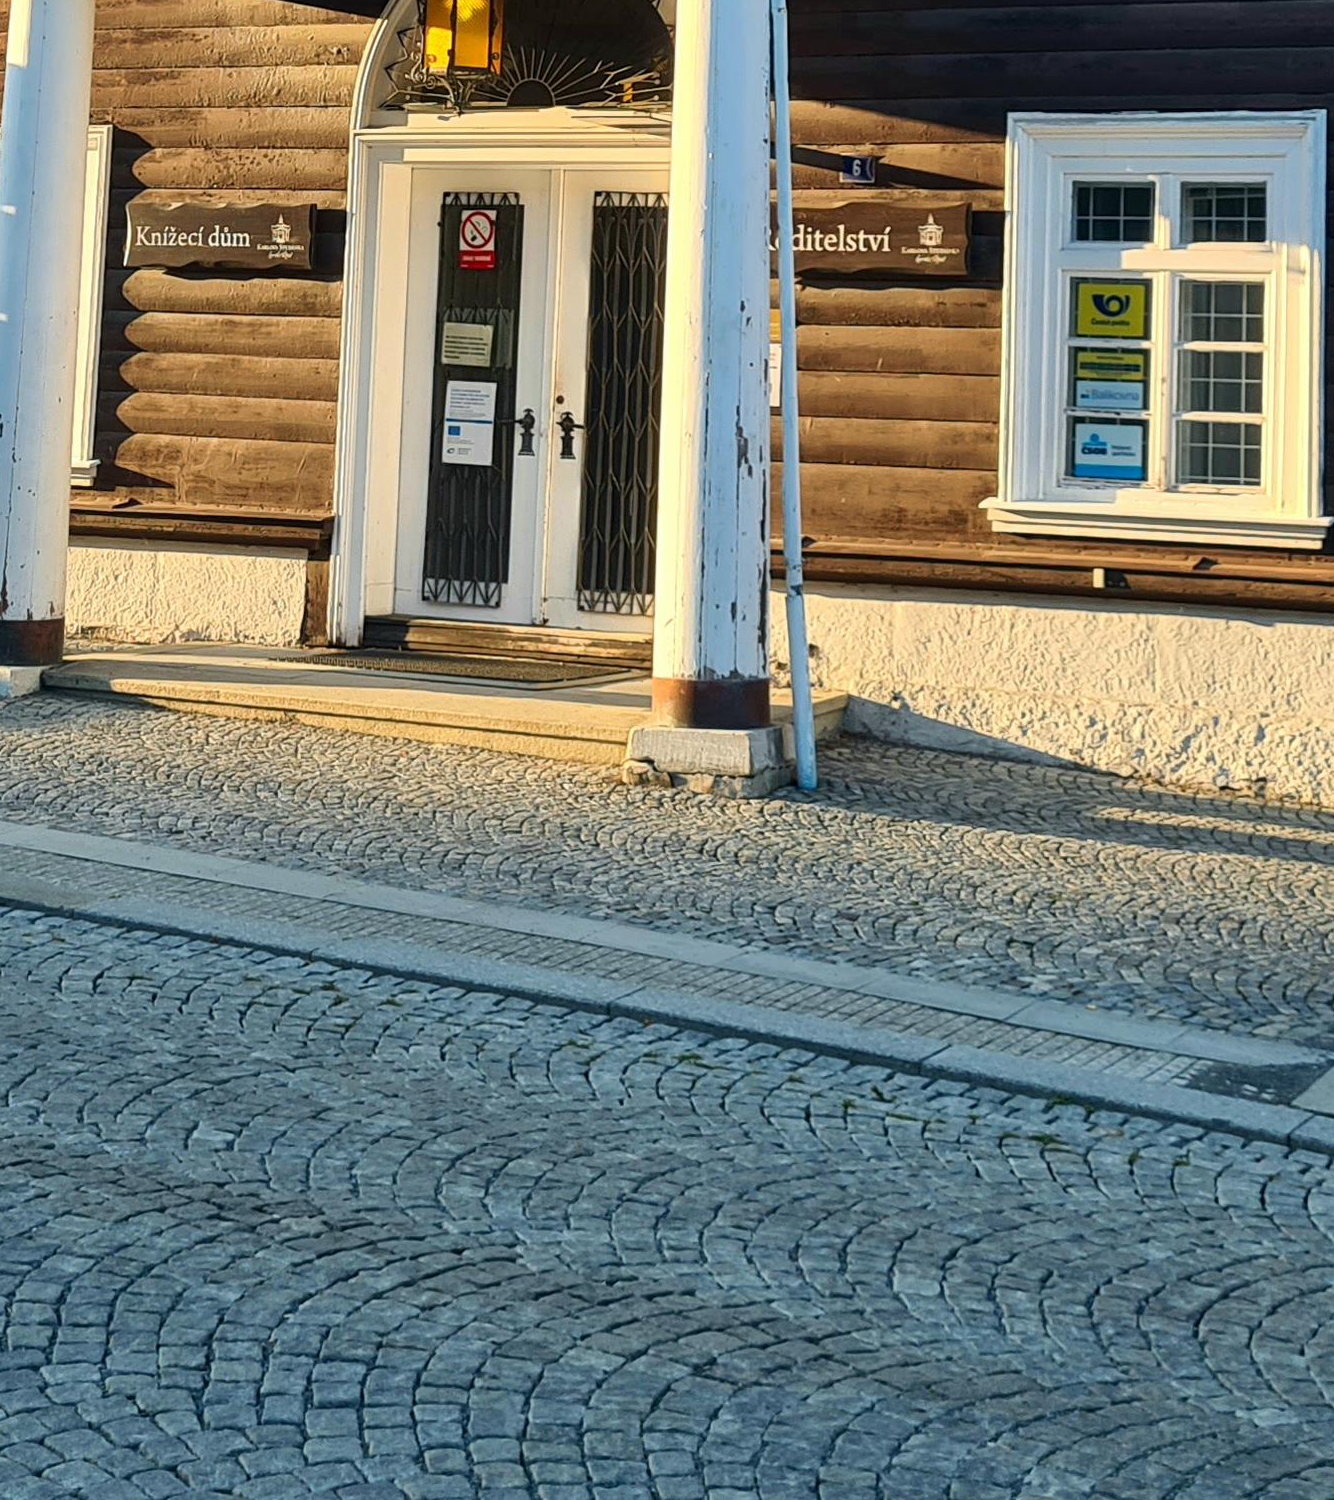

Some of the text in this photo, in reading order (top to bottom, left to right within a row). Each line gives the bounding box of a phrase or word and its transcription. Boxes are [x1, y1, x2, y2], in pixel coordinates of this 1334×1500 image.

[852, 159, 862, 176] 6
[135, 225, 251, 247] Knížecí dům
[768, 223, 892, 252] ditelství
